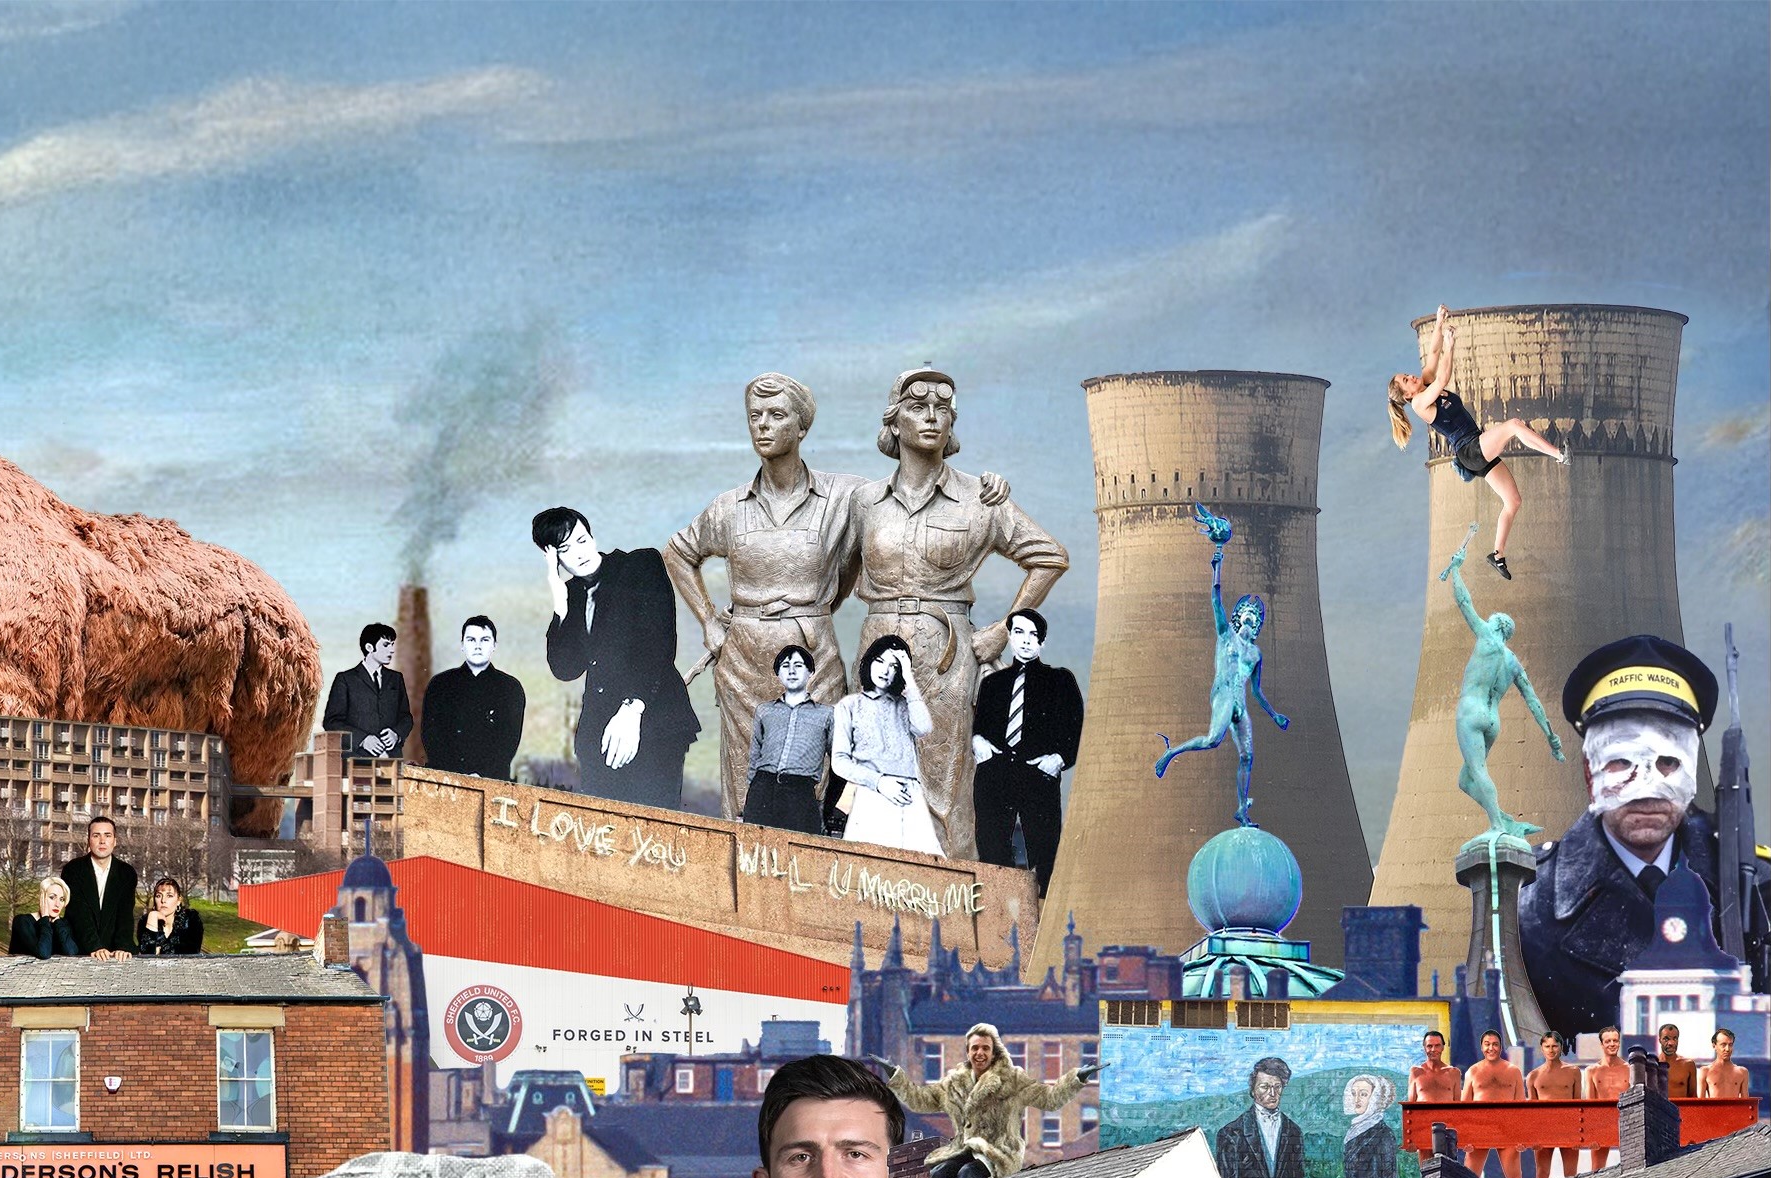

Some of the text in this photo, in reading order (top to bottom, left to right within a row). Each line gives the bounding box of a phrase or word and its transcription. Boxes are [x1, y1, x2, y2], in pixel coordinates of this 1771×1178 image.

[1609, 673, 1680, 689] TRAFFIC WARDEN
[491, 797, 986, 919] I LOVE YOU WILL U MARRY ME
[446, 986, 521, 1026] SHEFFIELD UNITED F.C.
[552, 1029, 715, 1043] FORGED IN STEEL
[129, 1150, 153, 1160] LTD.
